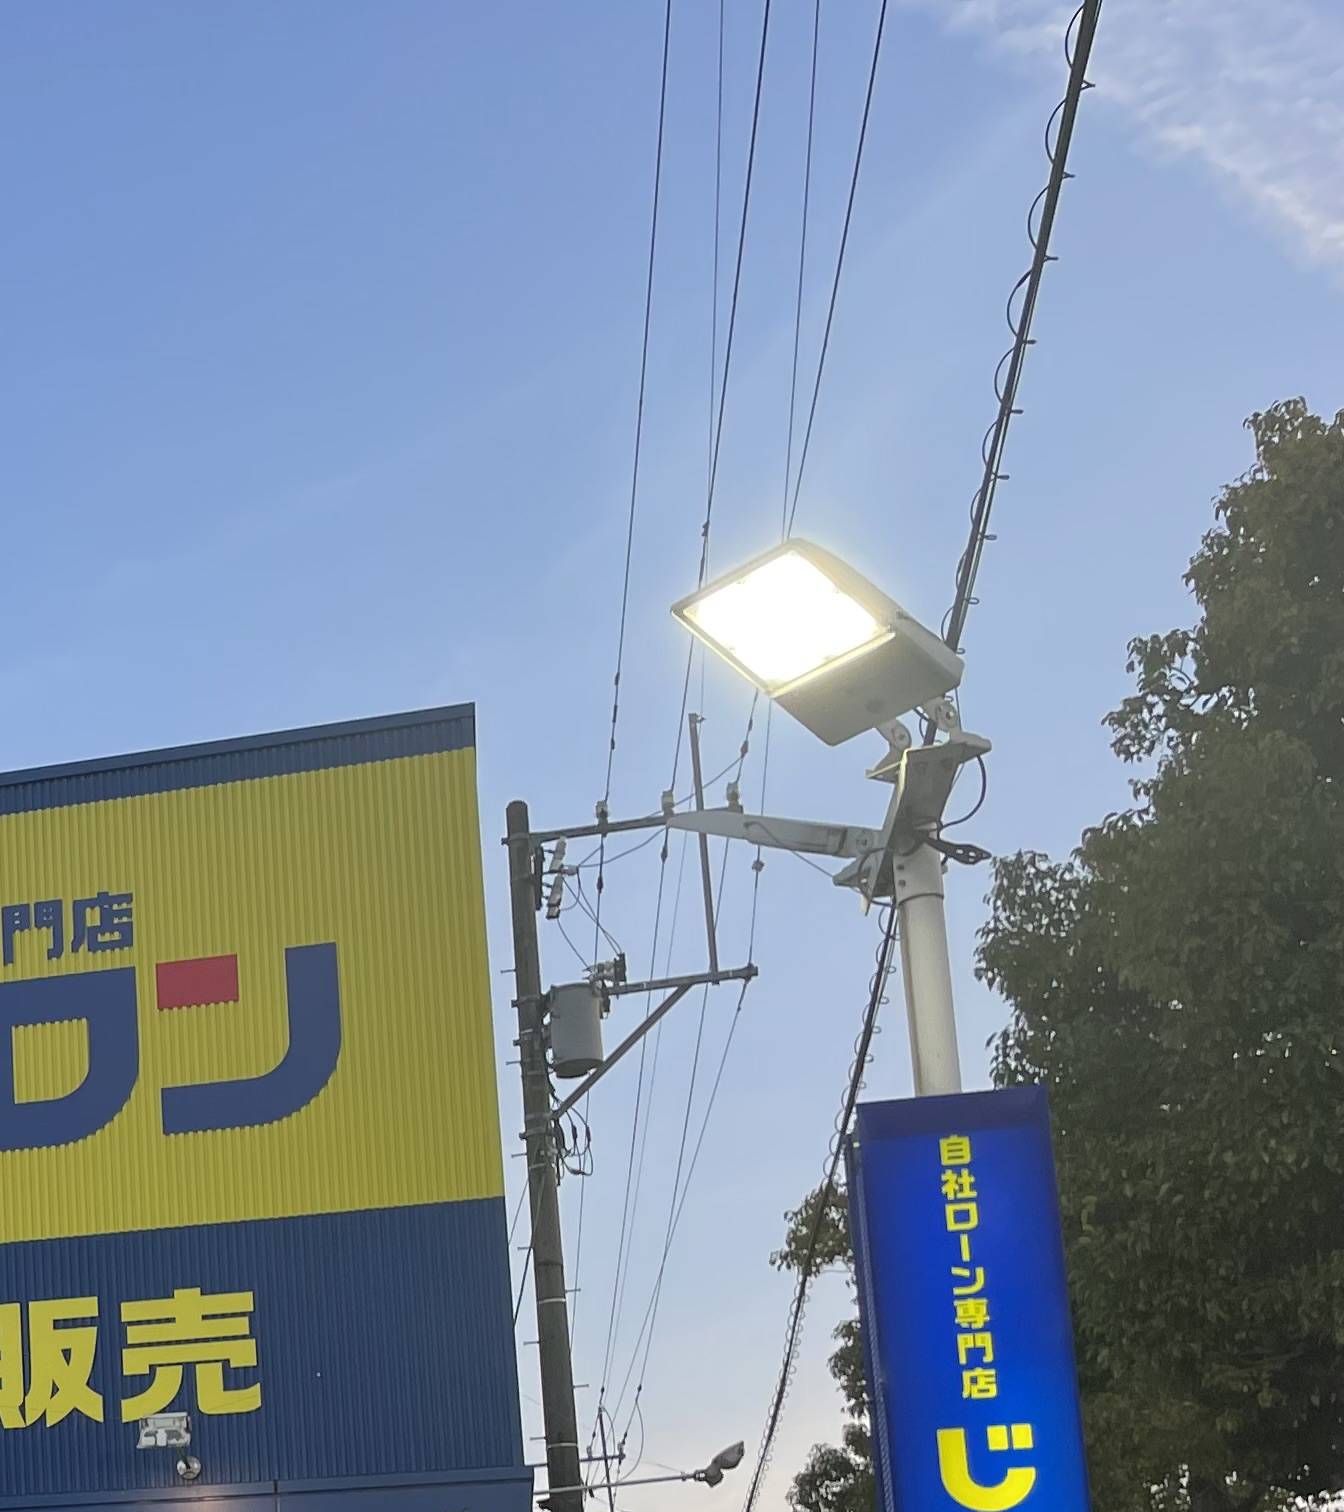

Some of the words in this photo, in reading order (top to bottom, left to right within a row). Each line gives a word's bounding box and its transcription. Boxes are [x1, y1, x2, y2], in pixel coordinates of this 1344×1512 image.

[938, 1134, 999, 1400] 自社ローン専門店
